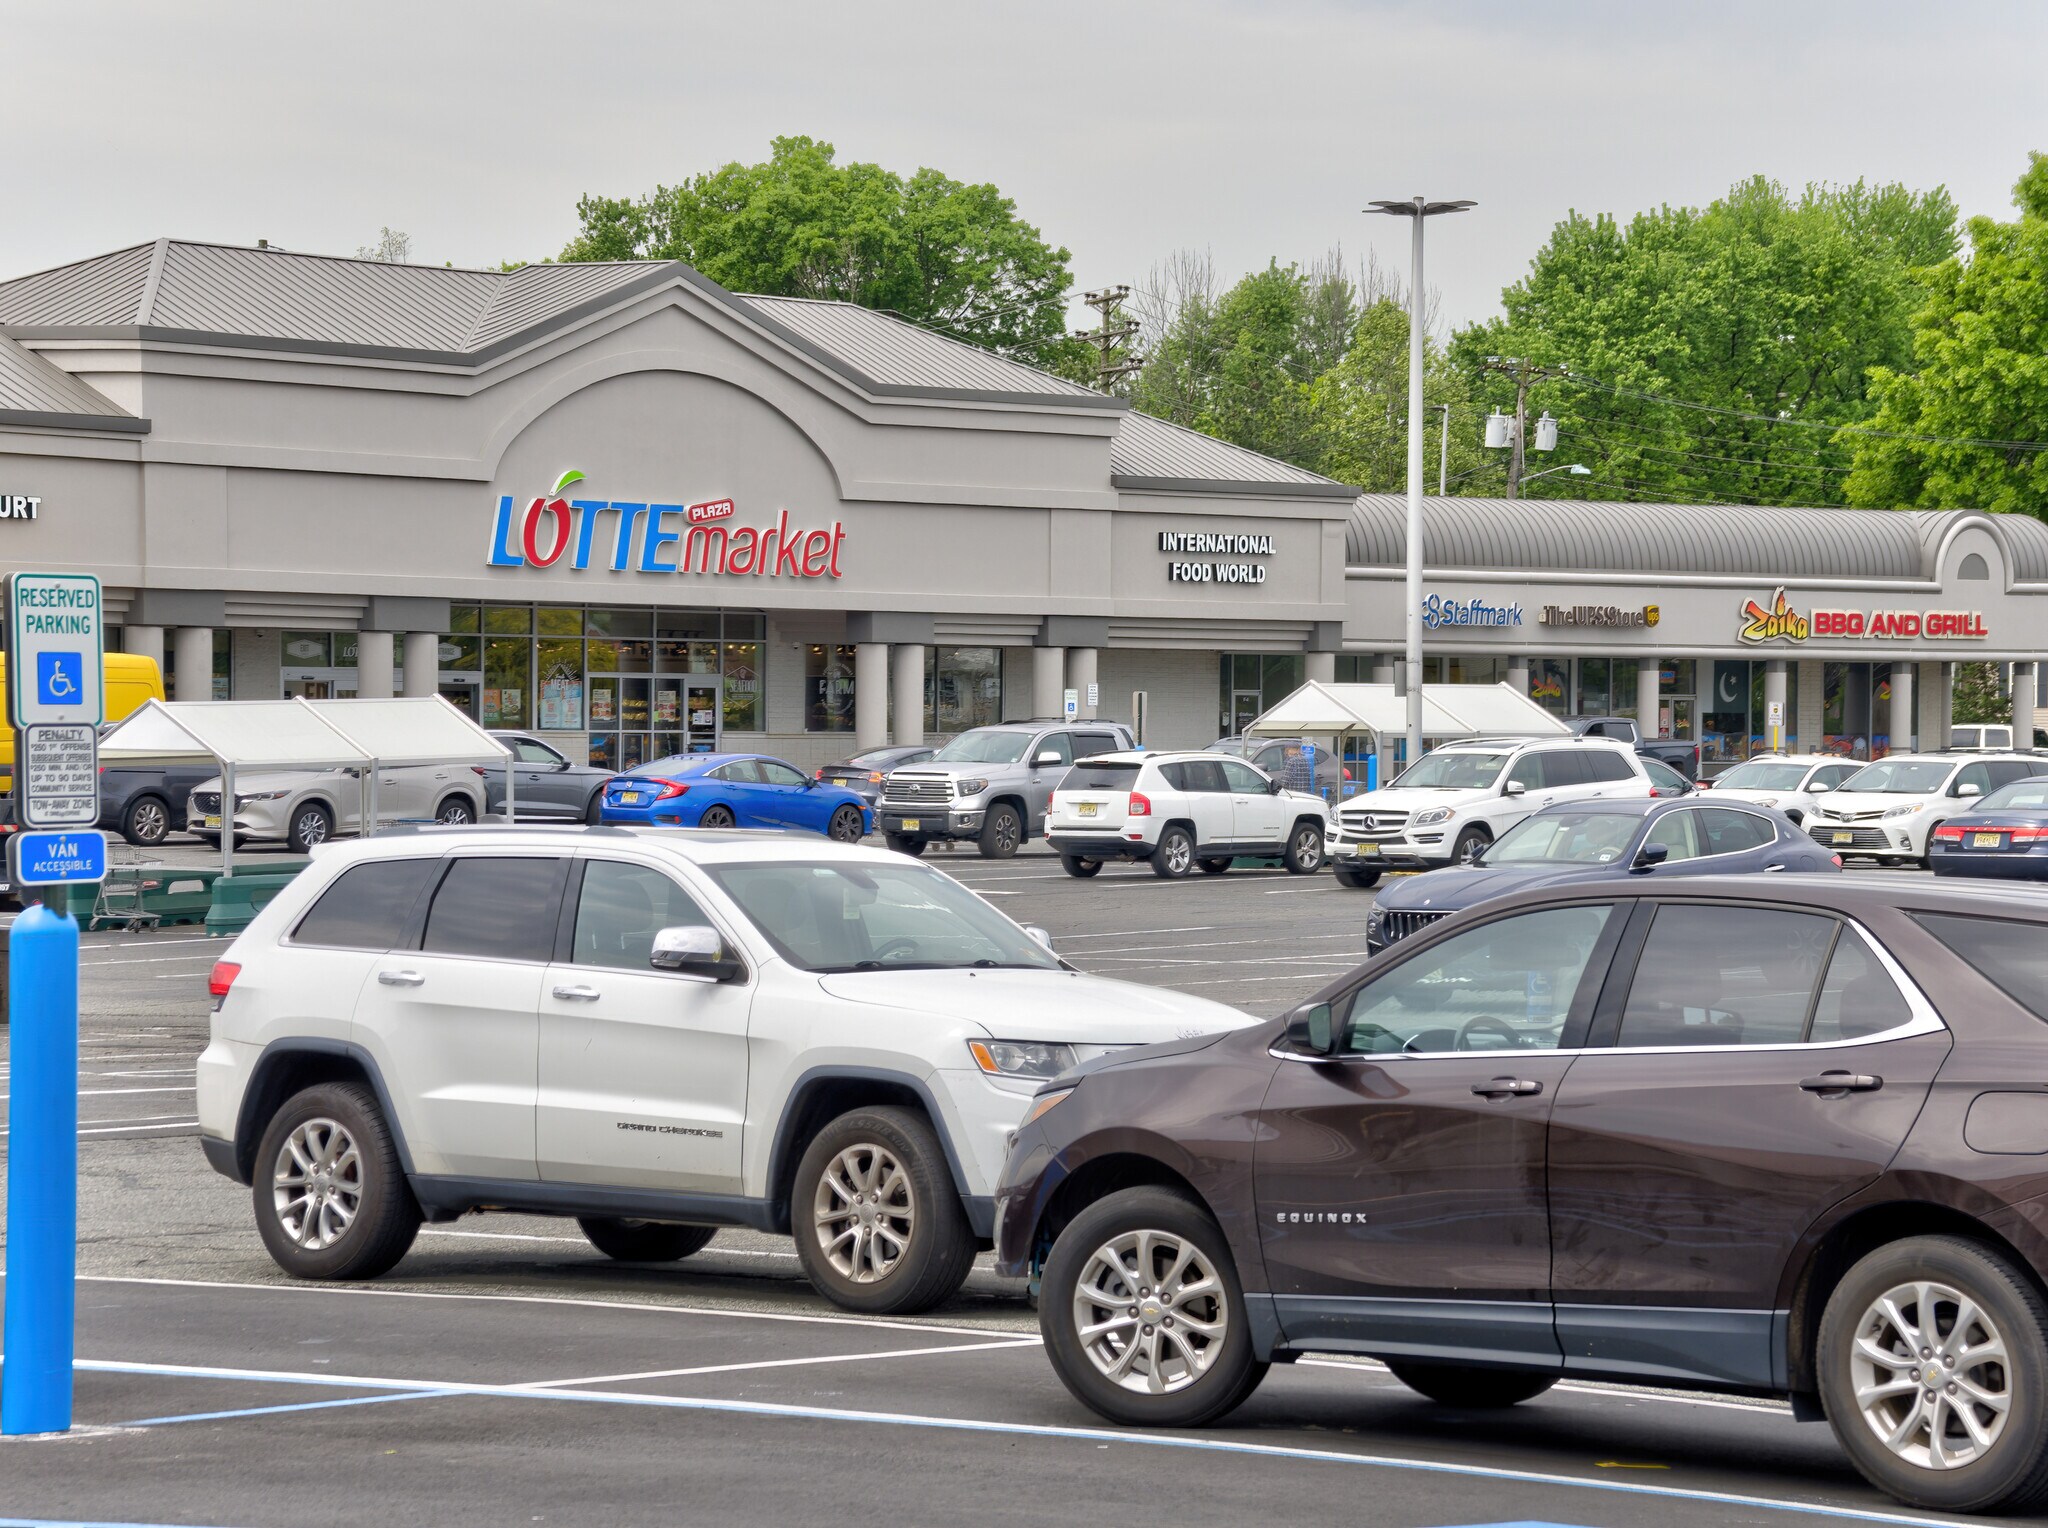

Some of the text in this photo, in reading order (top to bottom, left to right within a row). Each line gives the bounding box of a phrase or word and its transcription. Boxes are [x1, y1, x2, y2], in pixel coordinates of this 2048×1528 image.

[692, 503, 732, 518] PLAZA
[487, 495, 846, 578] LOTTE market
[1159, 532, 1277, 554] INTERNATIONAL
[1169, 562, 1266, 583] FOOD WORLD
[20, 588, 95, 608] RESERVED
[1441, 598, 1525, 627] Staffmark
[1544, 605, 1645, 627] The UPS Store
[1744, 599, 1988, 640] Zaika BBQ AND GRILL
[26, 614, 91, 635] PARKING
[38, 730, 84, 740] PENALTY
[60, 743, 92, 751] OFFENSE
[31, 773, 92, 782] UP TO 90 DAYS
[31, 784, 92, 793] COMMUNITY SERVICE
[31, 799, 93, 810] TOW-AWAY ZONE
[47, 843, 78, 858] VAN
[33, 860, 92, 872] ACCESSIBLE
[1276, 1212, 1367, 1224] EQUINOX
